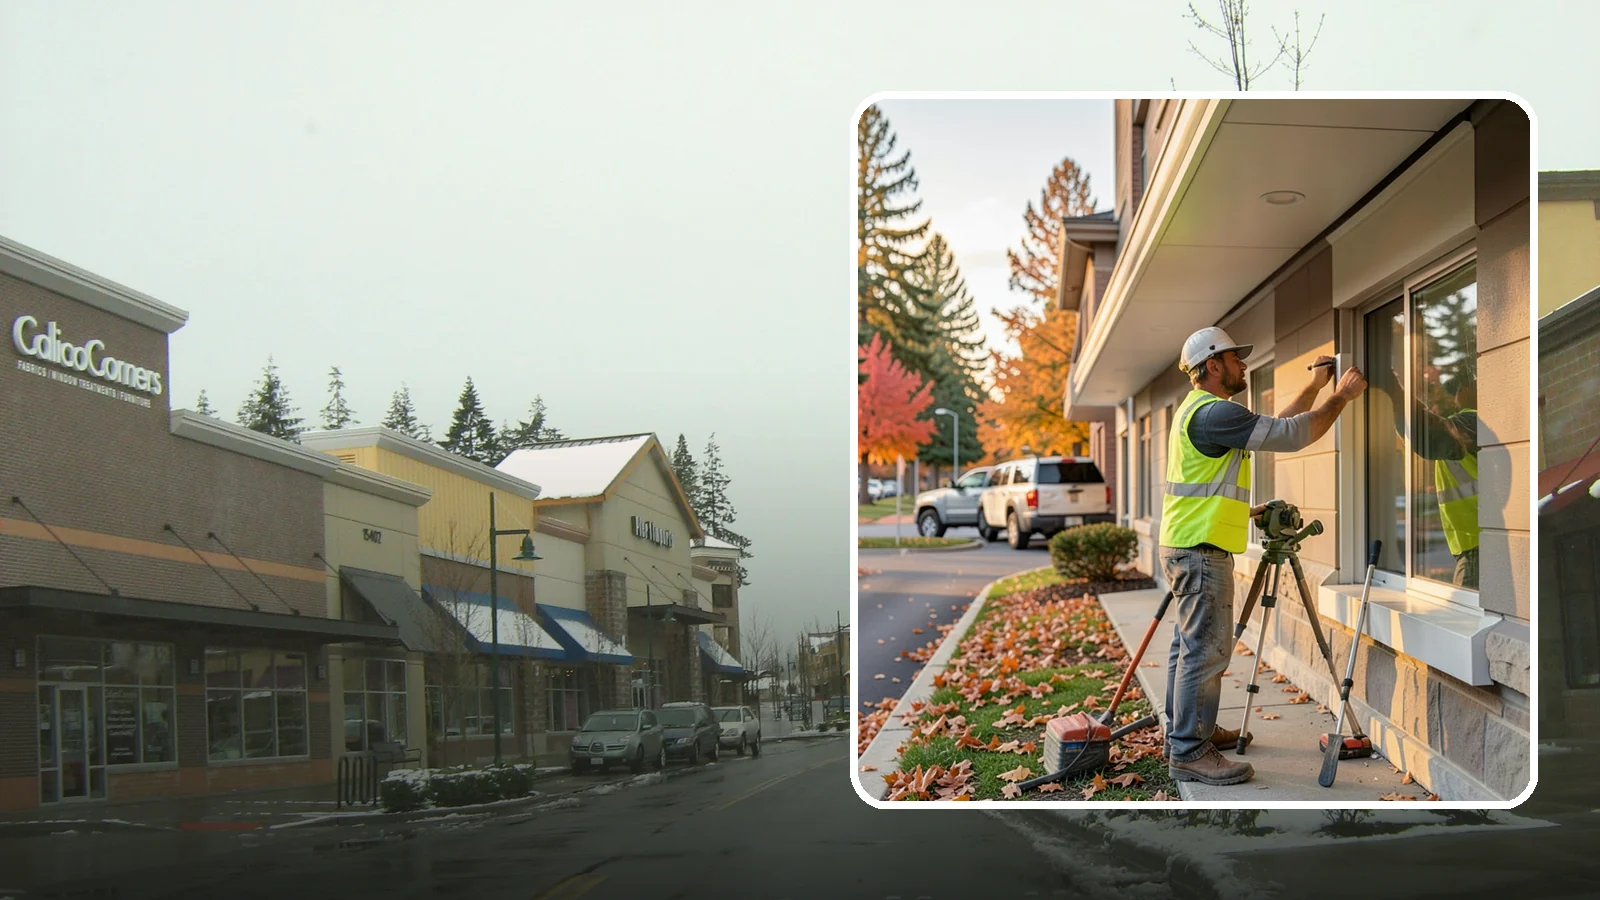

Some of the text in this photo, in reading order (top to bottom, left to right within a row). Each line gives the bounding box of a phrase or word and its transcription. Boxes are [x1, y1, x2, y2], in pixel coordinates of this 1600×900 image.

[17, 360, 151, 408] FABRICS WINDOW TREATMENTS FURNITURE
